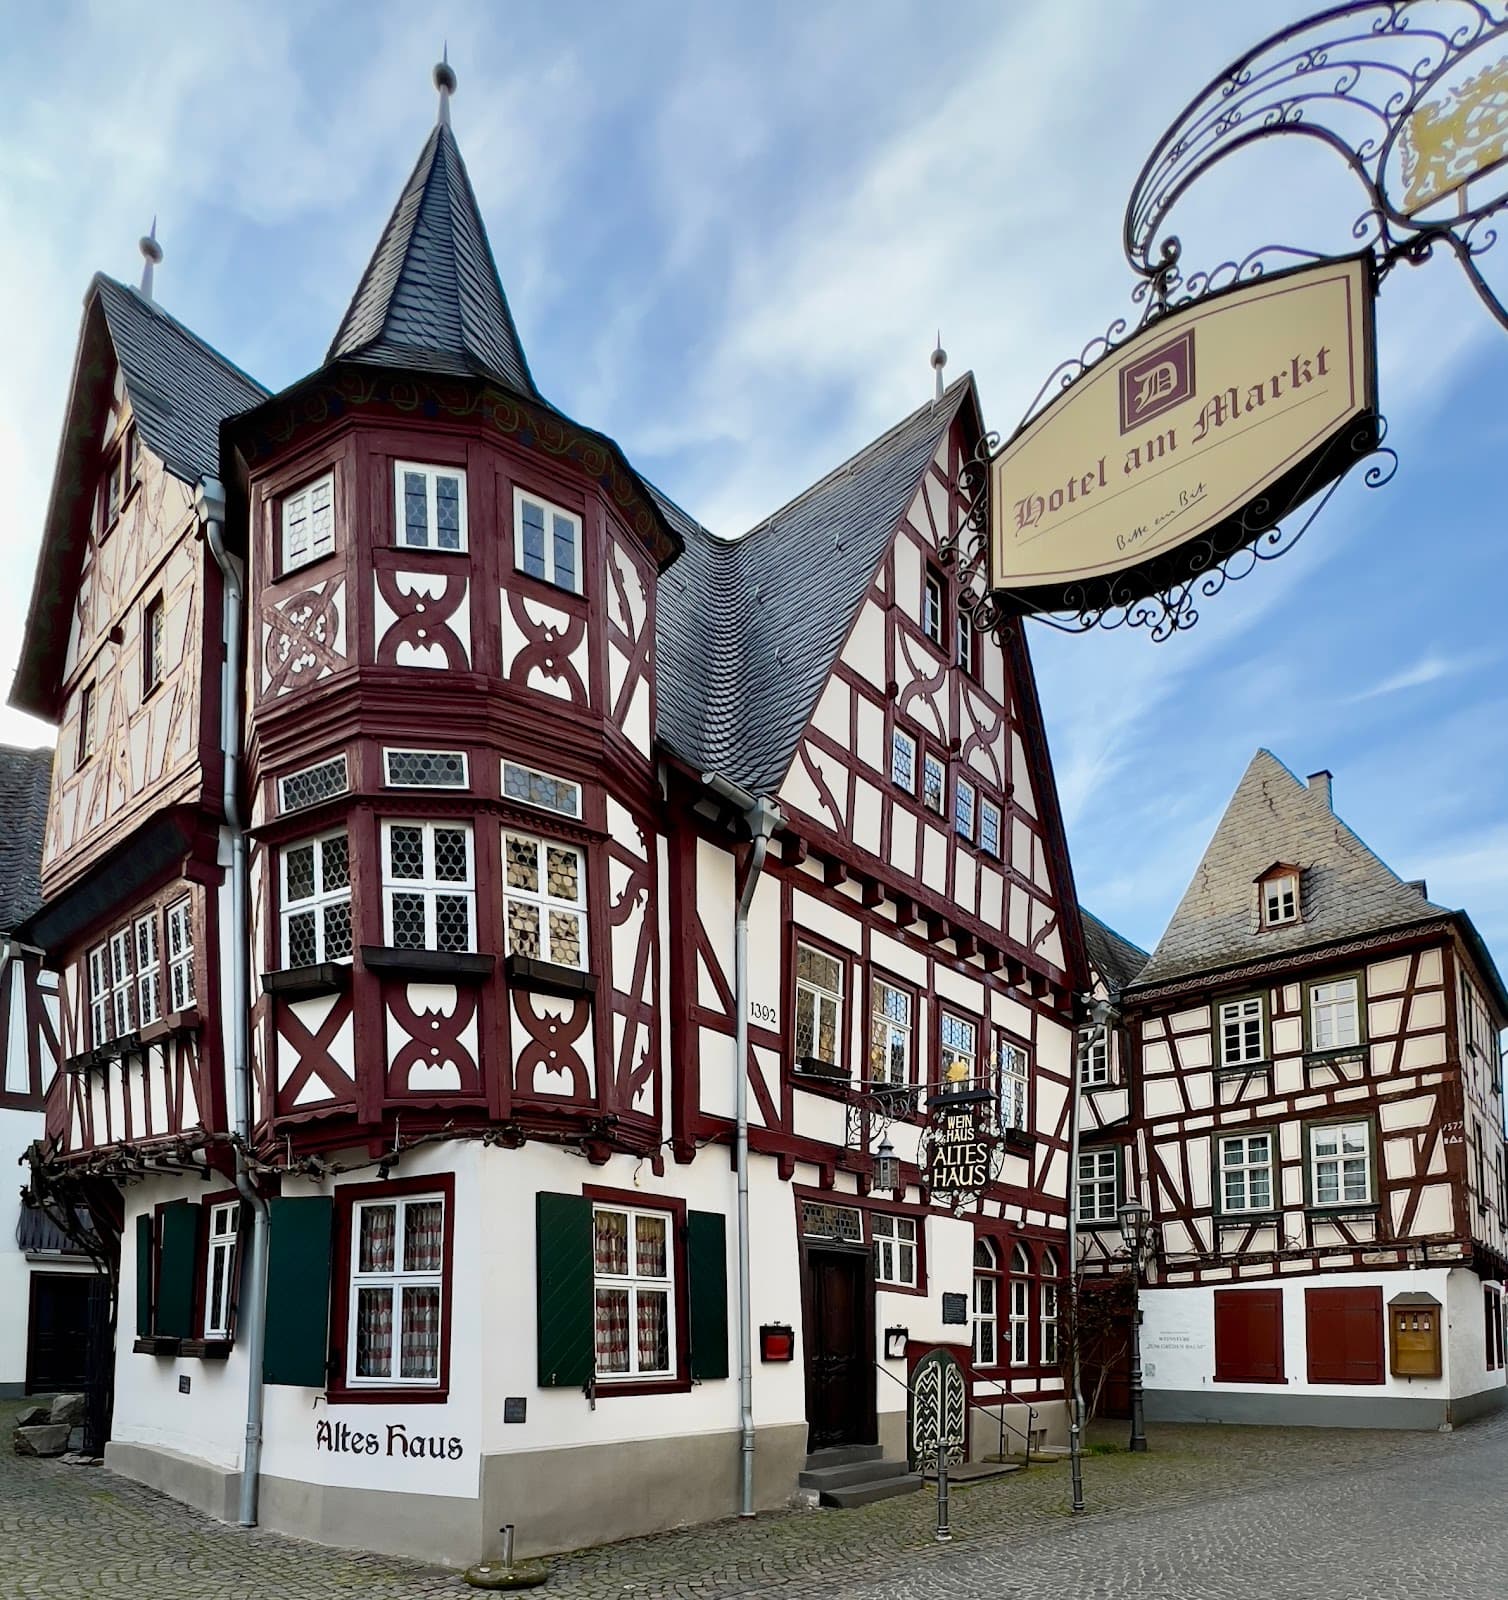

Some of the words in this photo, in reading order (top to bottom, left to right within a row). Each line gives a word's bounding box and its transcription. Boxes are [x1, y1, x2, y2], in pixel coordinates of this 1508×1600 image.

[1012, 459, 1108, 537] Hotel
[1122, 426, 1177, 477] am
[1192, 345, 1331, 444] Markt
[1116, 526, 1148, 550] Bitte
[1179, 481, 1207, 506] Bit
[947, 1114, 973, 1129] WEIN
[946, 1128, 975, 1143] HAUS
[932, 1143, 988, 1167] ALTES
[932, 1164, 986, 1188] HAUS
[316, 1420, 379, 1455] Altes
[386, 1424, 464, 1460] Haus
